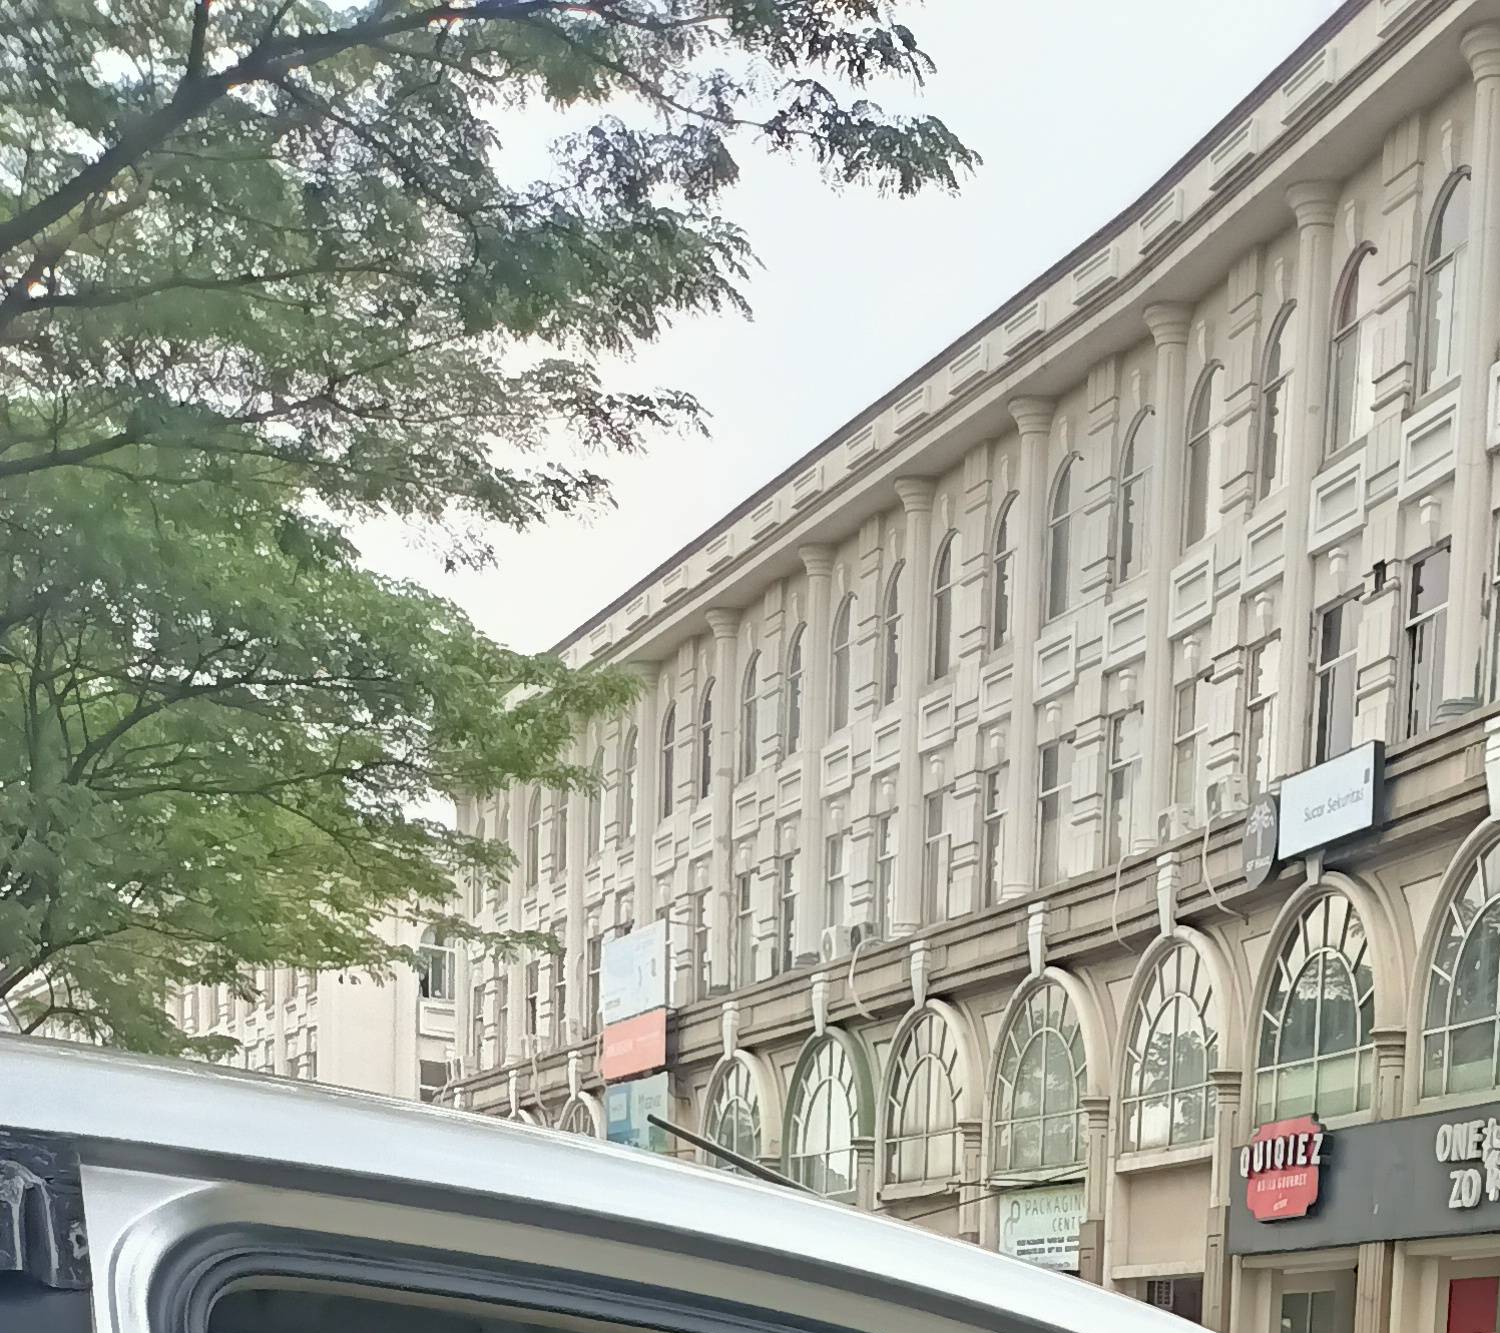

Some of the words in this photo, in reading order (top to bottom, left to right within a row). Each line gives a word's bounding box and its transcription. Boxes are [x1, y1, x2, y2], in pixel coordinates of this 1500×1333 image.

[1240, 1132, 1324, 1178] QUIQIEZ
[1435, 1119, 1485, 1163] ONE
[1449, 1168, 1482, 1209] ZO
